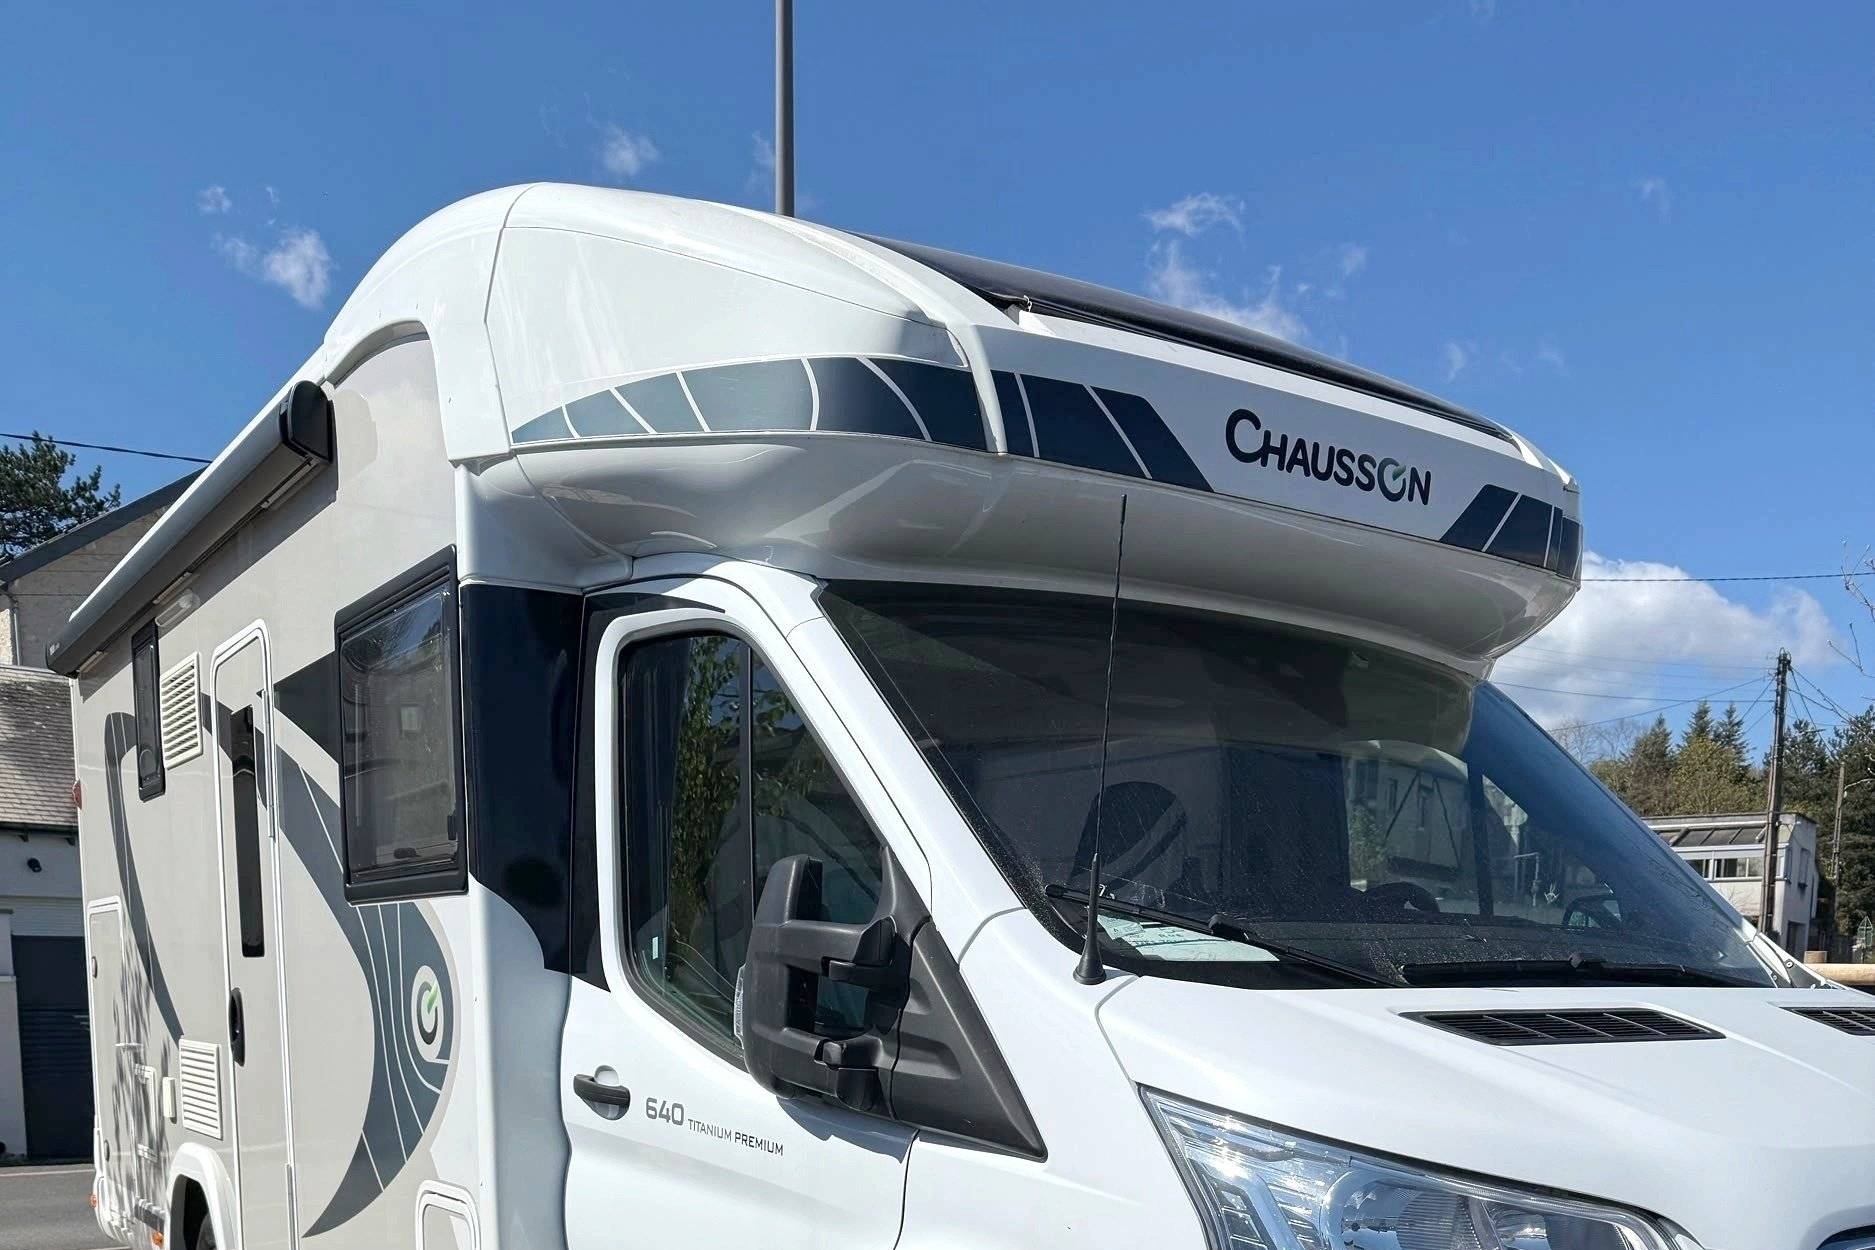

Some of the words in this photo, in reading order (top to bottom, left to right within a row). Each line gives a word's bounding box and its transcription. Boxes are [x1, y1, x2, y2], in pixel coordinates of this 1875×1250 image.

[1225, 408, 1432, 506] CHAUSSON
[645, 1097, 685, 1126] 640
[688, 1118, 732, 1142] TITANIUM
[734, 1131, 784, 1157] PREMIUM
